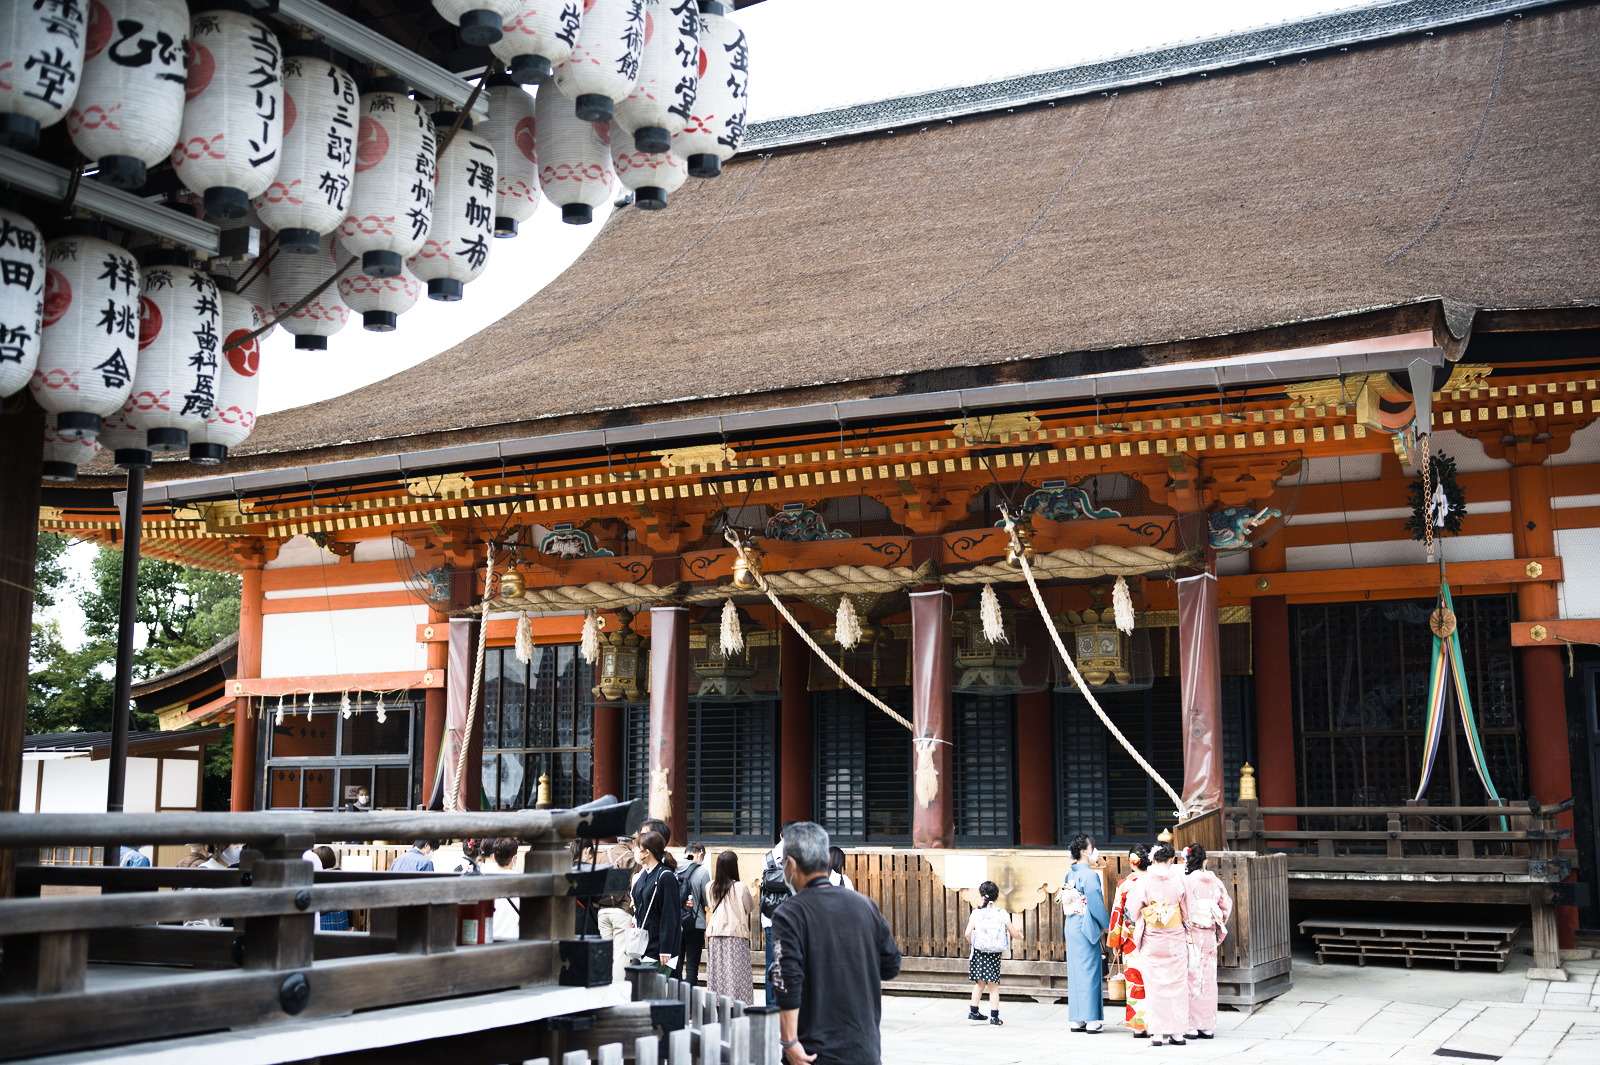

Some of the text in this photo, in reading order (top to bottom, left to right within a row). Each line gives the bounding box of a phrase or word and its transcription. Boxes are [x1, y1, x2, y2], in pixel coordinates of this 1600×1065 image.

[456, 141, 495, 271] 一澤帆布
[179, 271, 220, 419] 村井歯科医院
